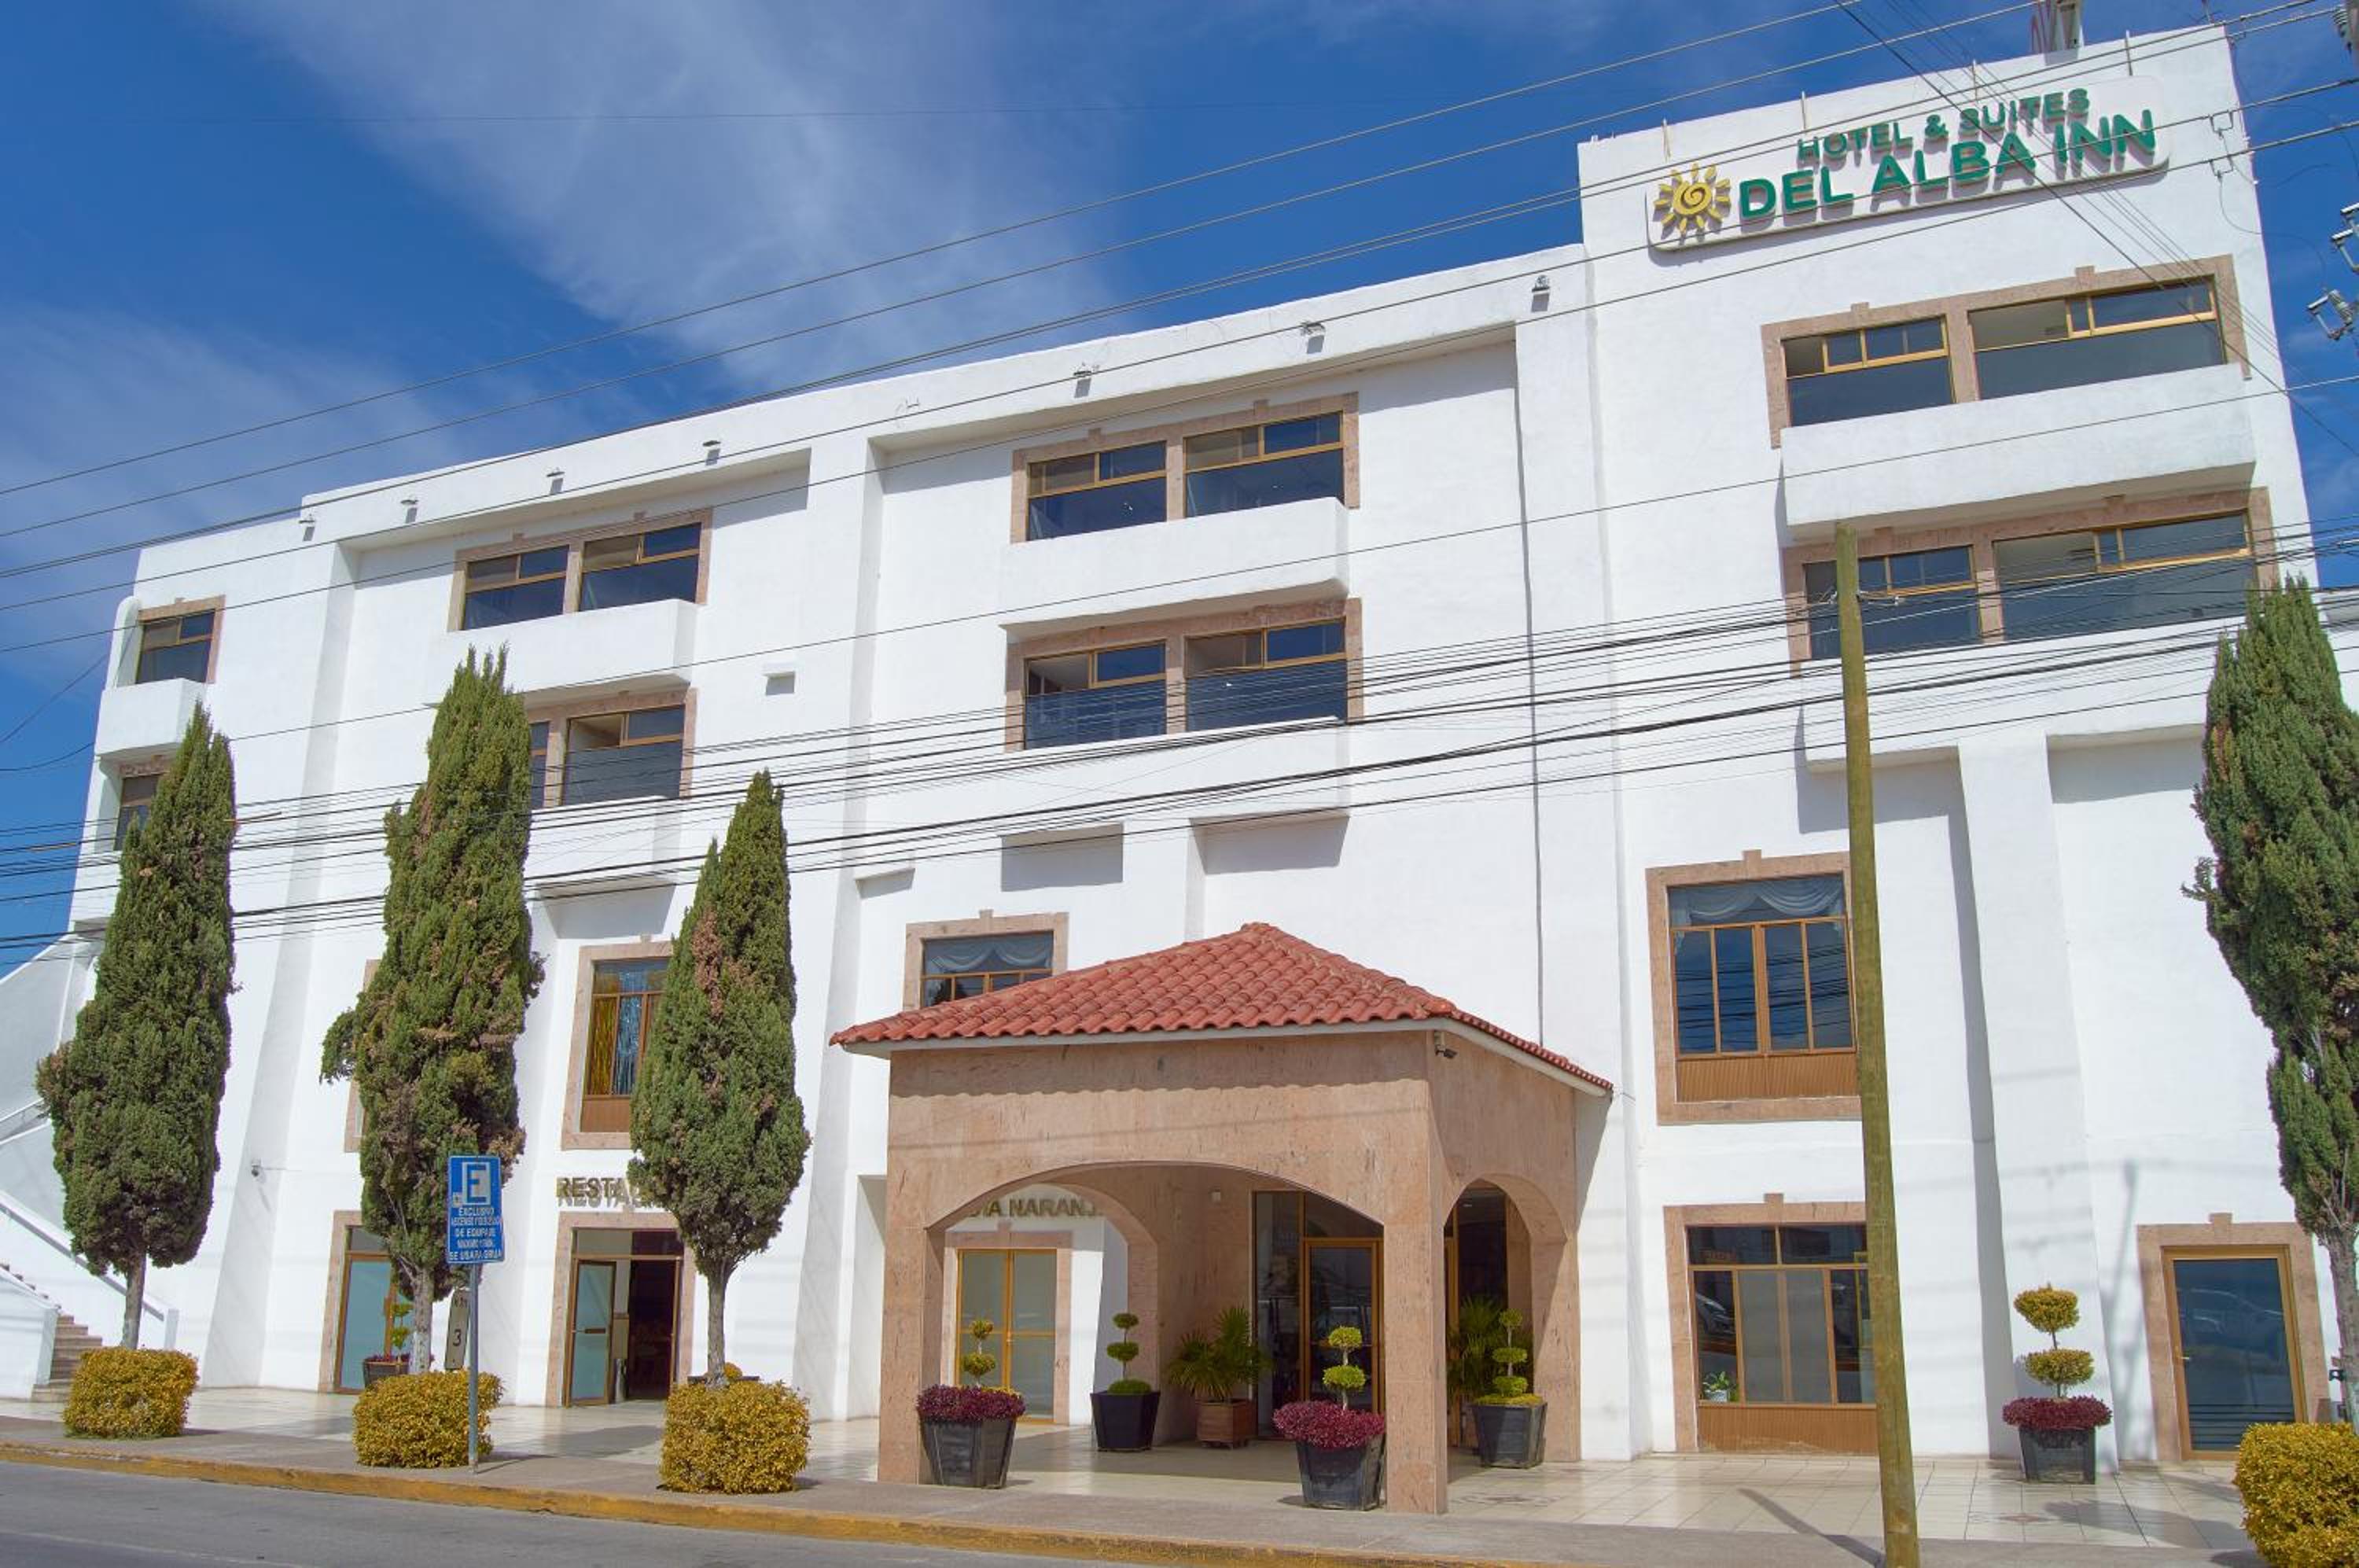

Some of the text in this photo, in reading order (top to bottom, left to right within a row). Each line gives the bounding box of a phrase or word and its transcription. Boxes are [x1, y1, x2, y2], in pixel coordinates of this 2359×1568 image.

[1798, 87, 2090, 161] HOTEL & SUITES
[1739, 109, 2156, 218] DEL ALBA INN
[467, 1165, 487, 1203] E
[458, 1207, 495, 1216] EXCLUSIVO
[452, 1329, 462, 1346] 3
